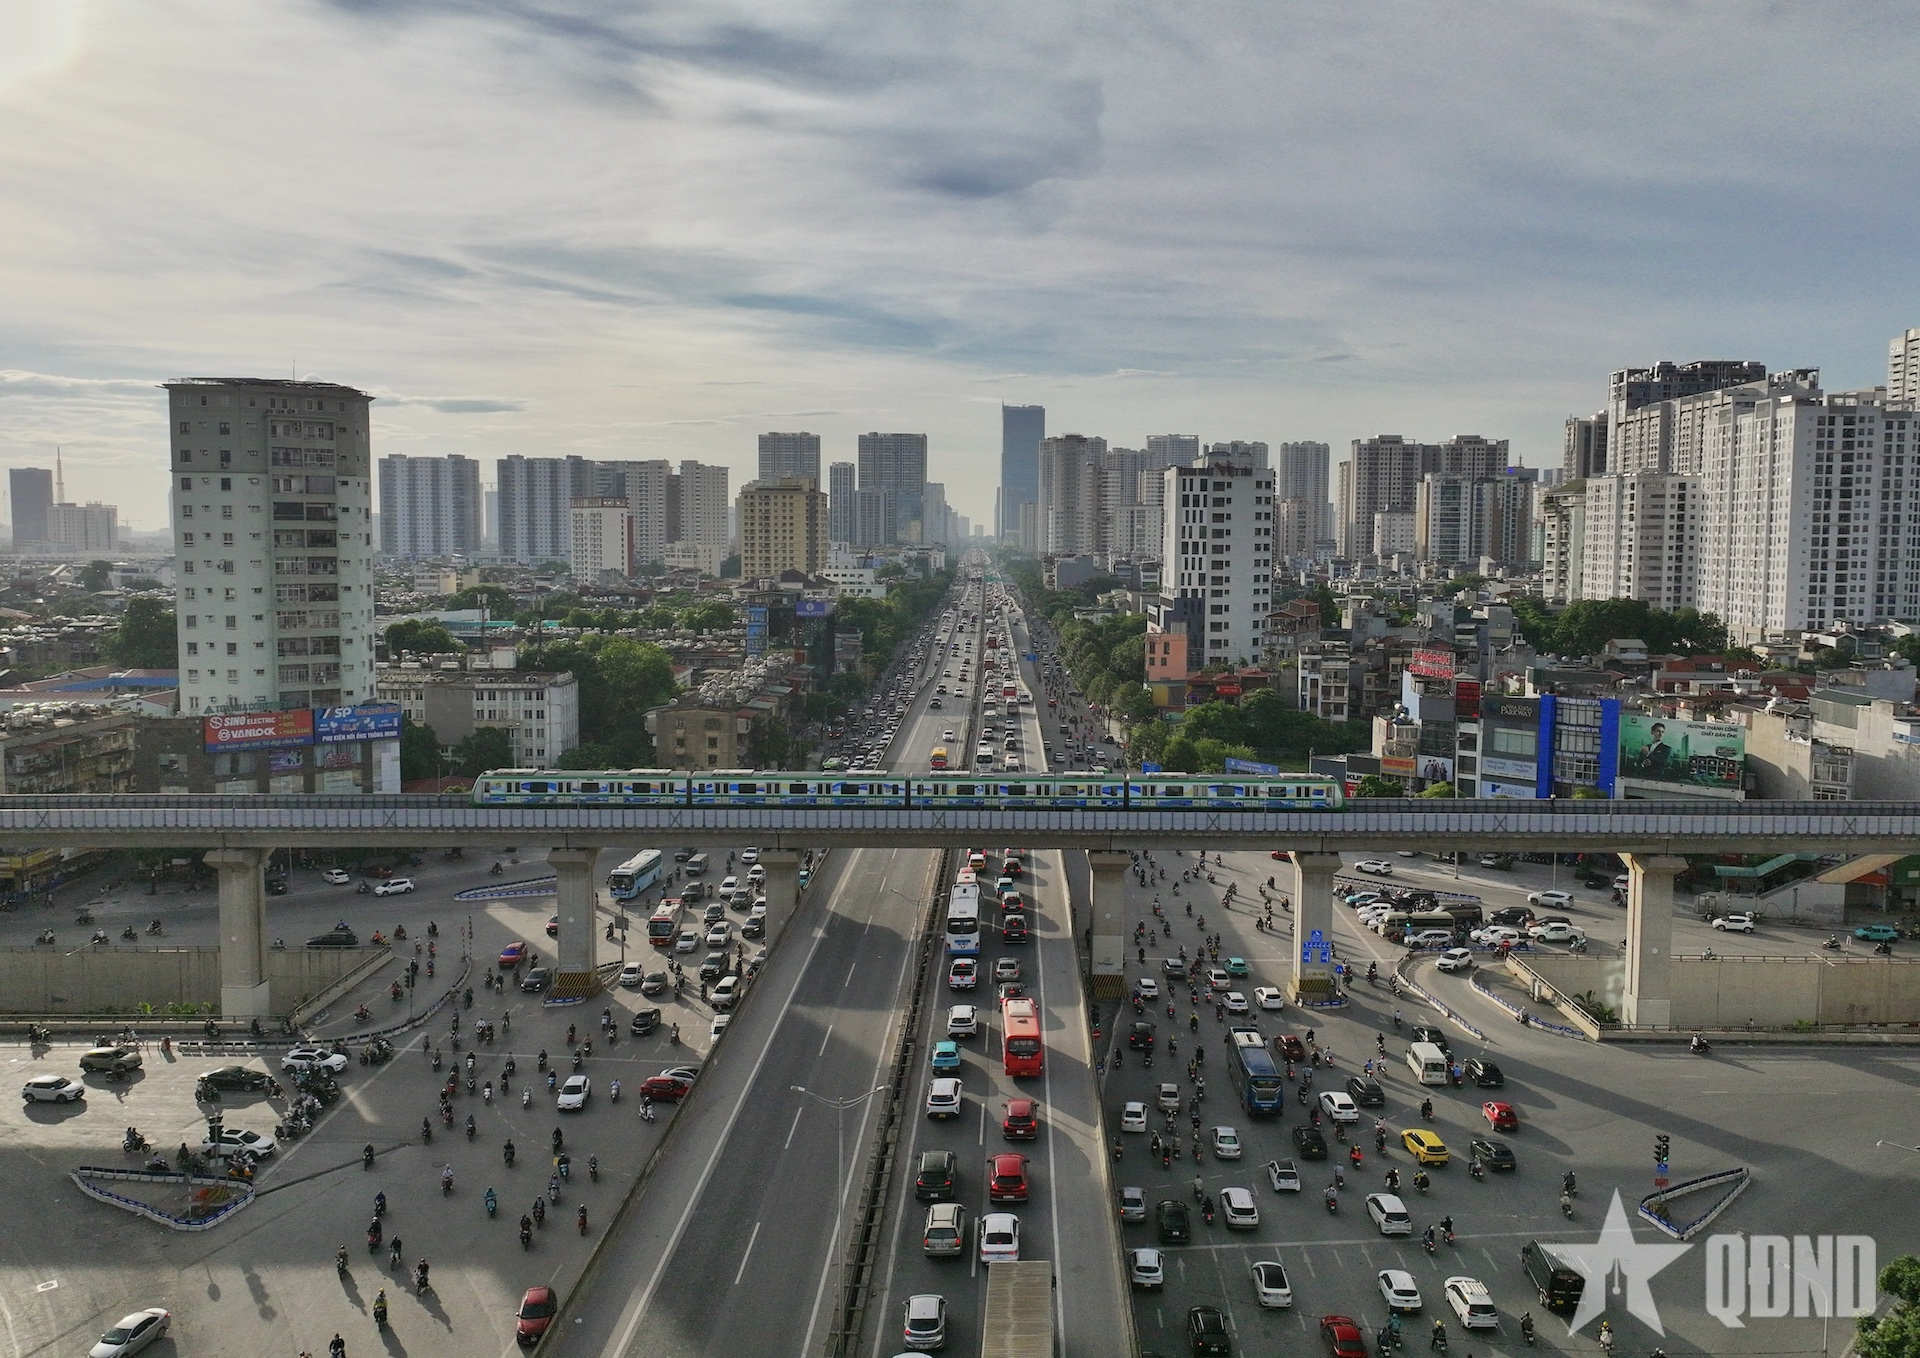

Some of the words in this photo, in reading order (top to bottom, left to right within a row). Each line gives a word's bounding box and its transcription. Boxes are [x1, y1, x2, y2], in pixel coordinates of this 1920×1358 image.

[334, 707, 352, 718] SP
[1500, 705, 1533, 717] PARKWAY
[224, 716, 246, 727] SINO
[246, 717, 276, 725] ELECTRIC
[231, 727, 276, 739] VANLOCK
